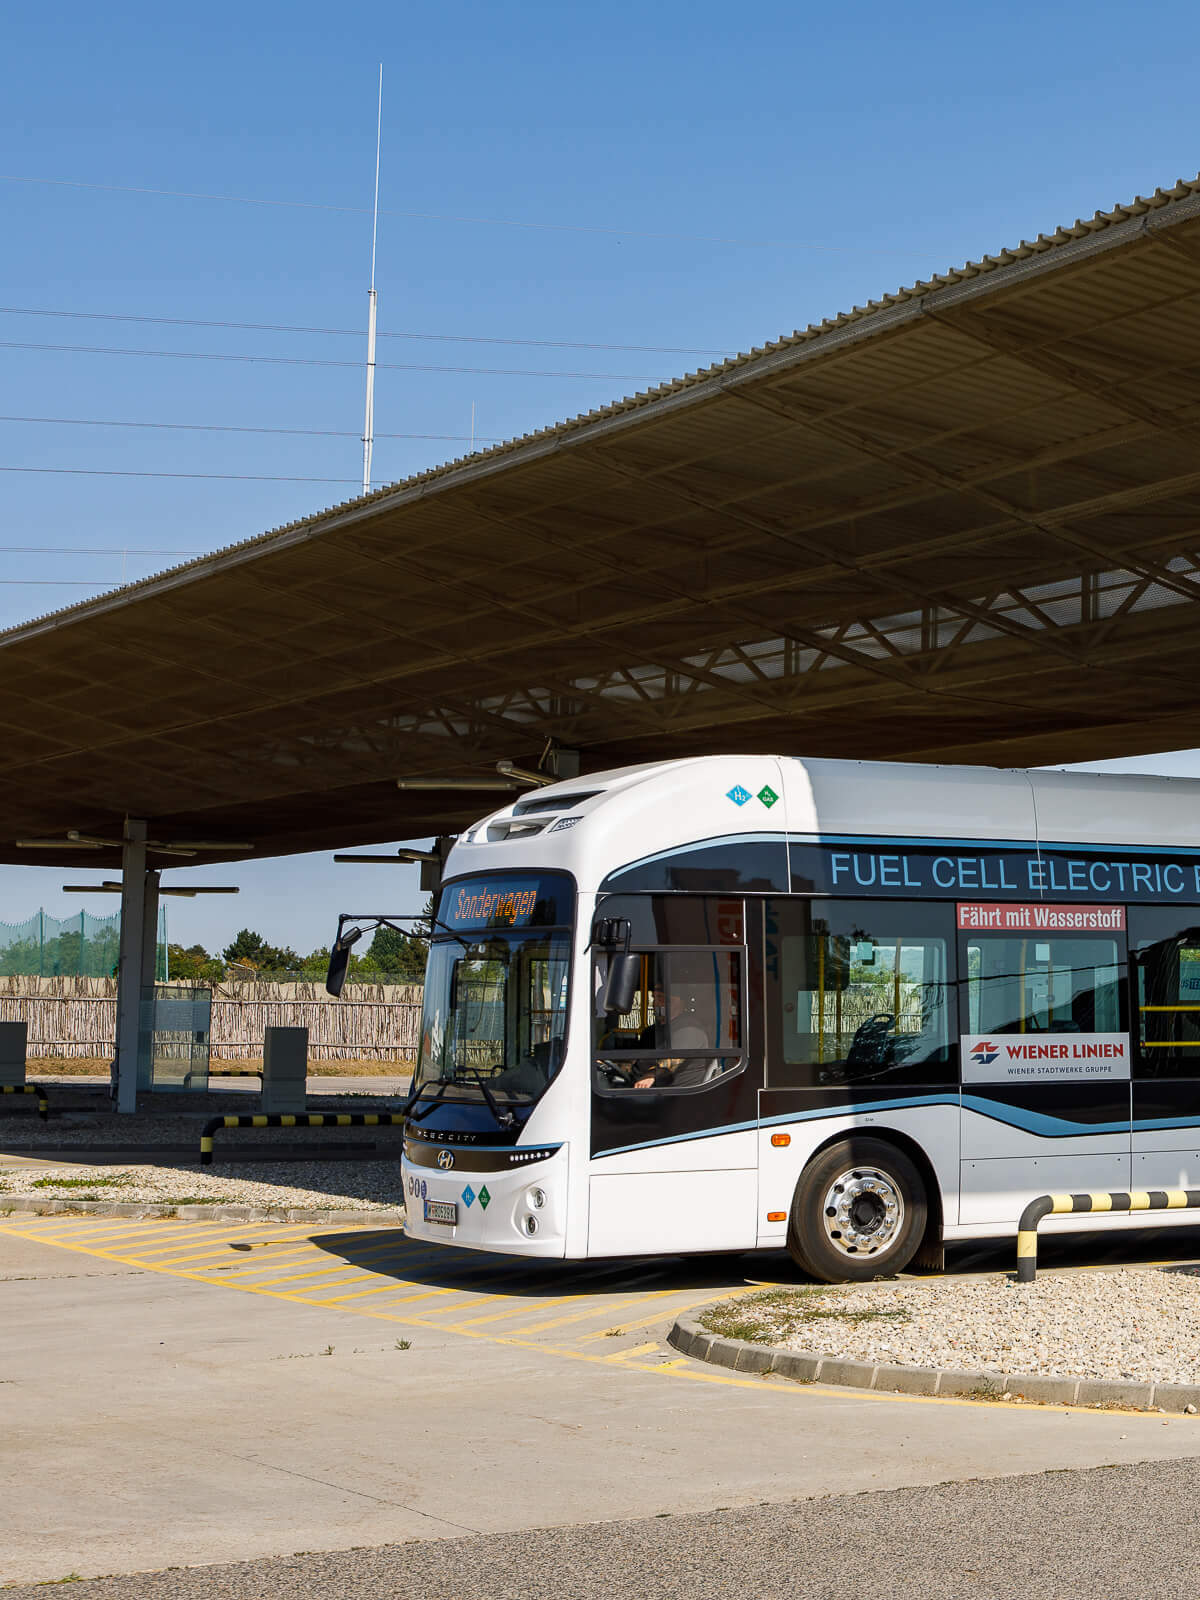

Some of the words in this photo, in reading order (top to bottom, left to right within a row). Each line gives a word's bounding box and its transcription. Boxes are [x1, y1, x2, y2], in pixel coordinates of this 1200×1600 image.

[831, 854, 921, 888] FUEL
[932, 857, 1017, 890] CELL
[1028, 860, 1185, 893] ELECTRIC
[455, 888, 536, 924] Sonderwagen
[960, 906, 1002, 927] Fährt
[1006, 908, 1031, 927] mit
[1034, 909, 1122, 928] Wasserstoff
[1006, 1045, 1069, 1059] WIENER
[1073, 1044, 1124, 1058] LINIEN
